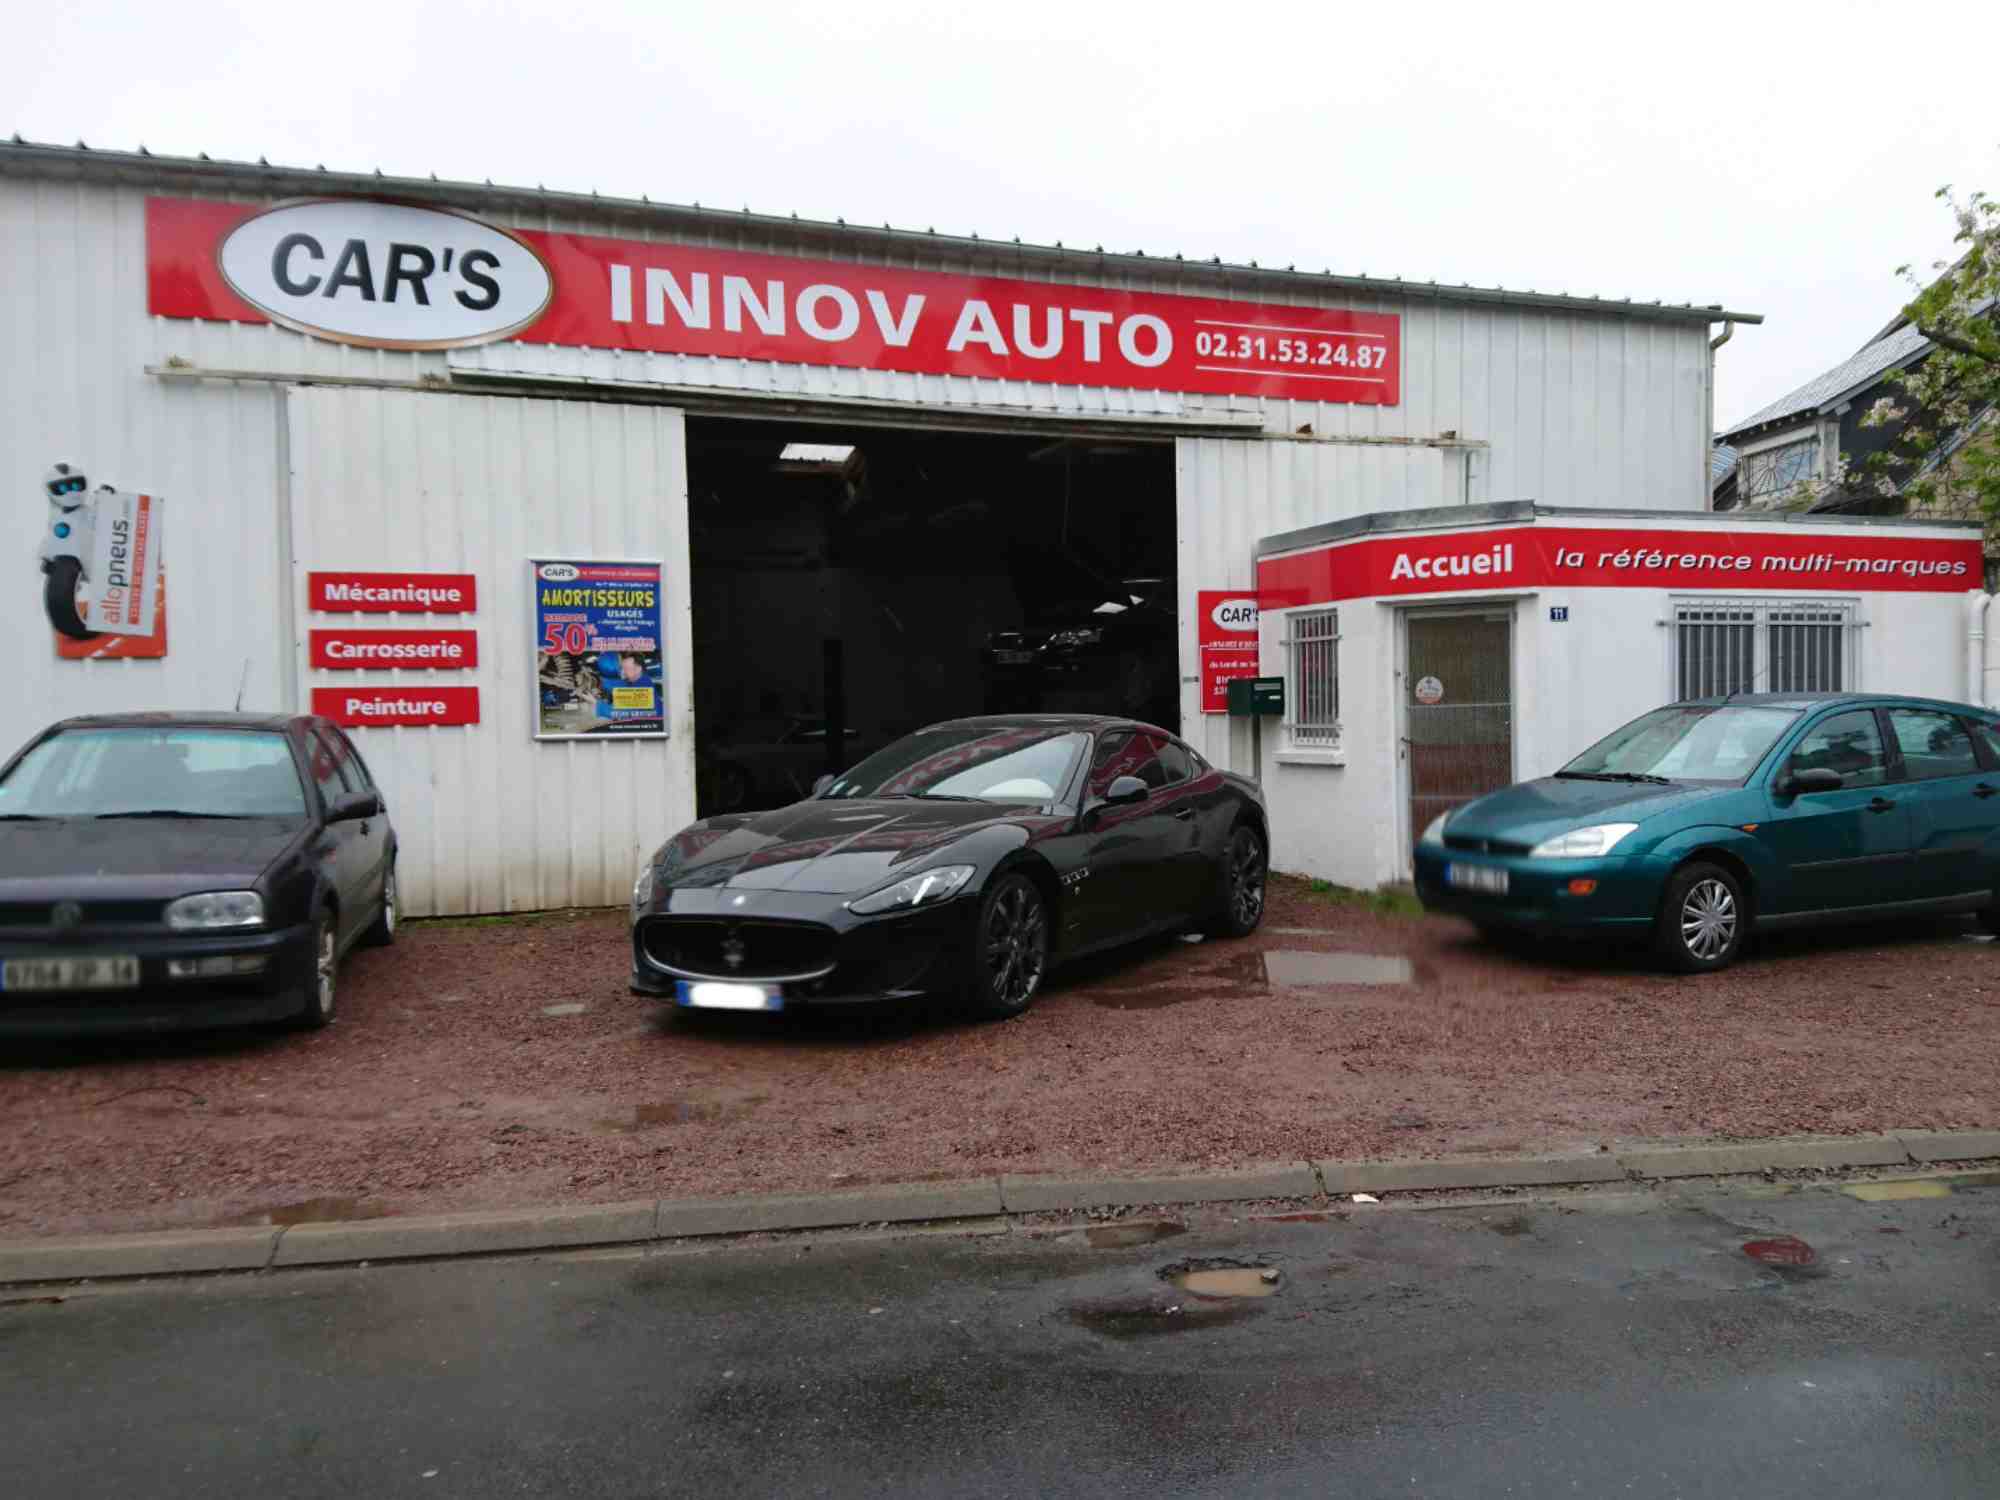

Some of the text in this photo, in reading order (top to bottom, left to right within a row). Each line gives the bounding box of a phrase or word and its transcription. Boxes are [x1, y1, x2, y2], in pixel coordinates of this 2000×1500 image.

[271, 232, 502, 312] CAR'S
[609, 263, 1175, 368] INNOV AUTO
[1195, 331, 1388, 369] 02.31.53.24.87
[544, 567, 574, 577] CAR'S
[1390, 543, 1513, 581] Accueil
[1555, 547, 1968, 576] la référence multi-marques
[324, 582, 462, 607] Mécanique
[542, 588, 655, 608] AMORTISSEURS
[1552, 607, 1565, 621] 11
[325, 639, 463, 659] Carrosserie
[346, 697, 447, 716] Peinture
